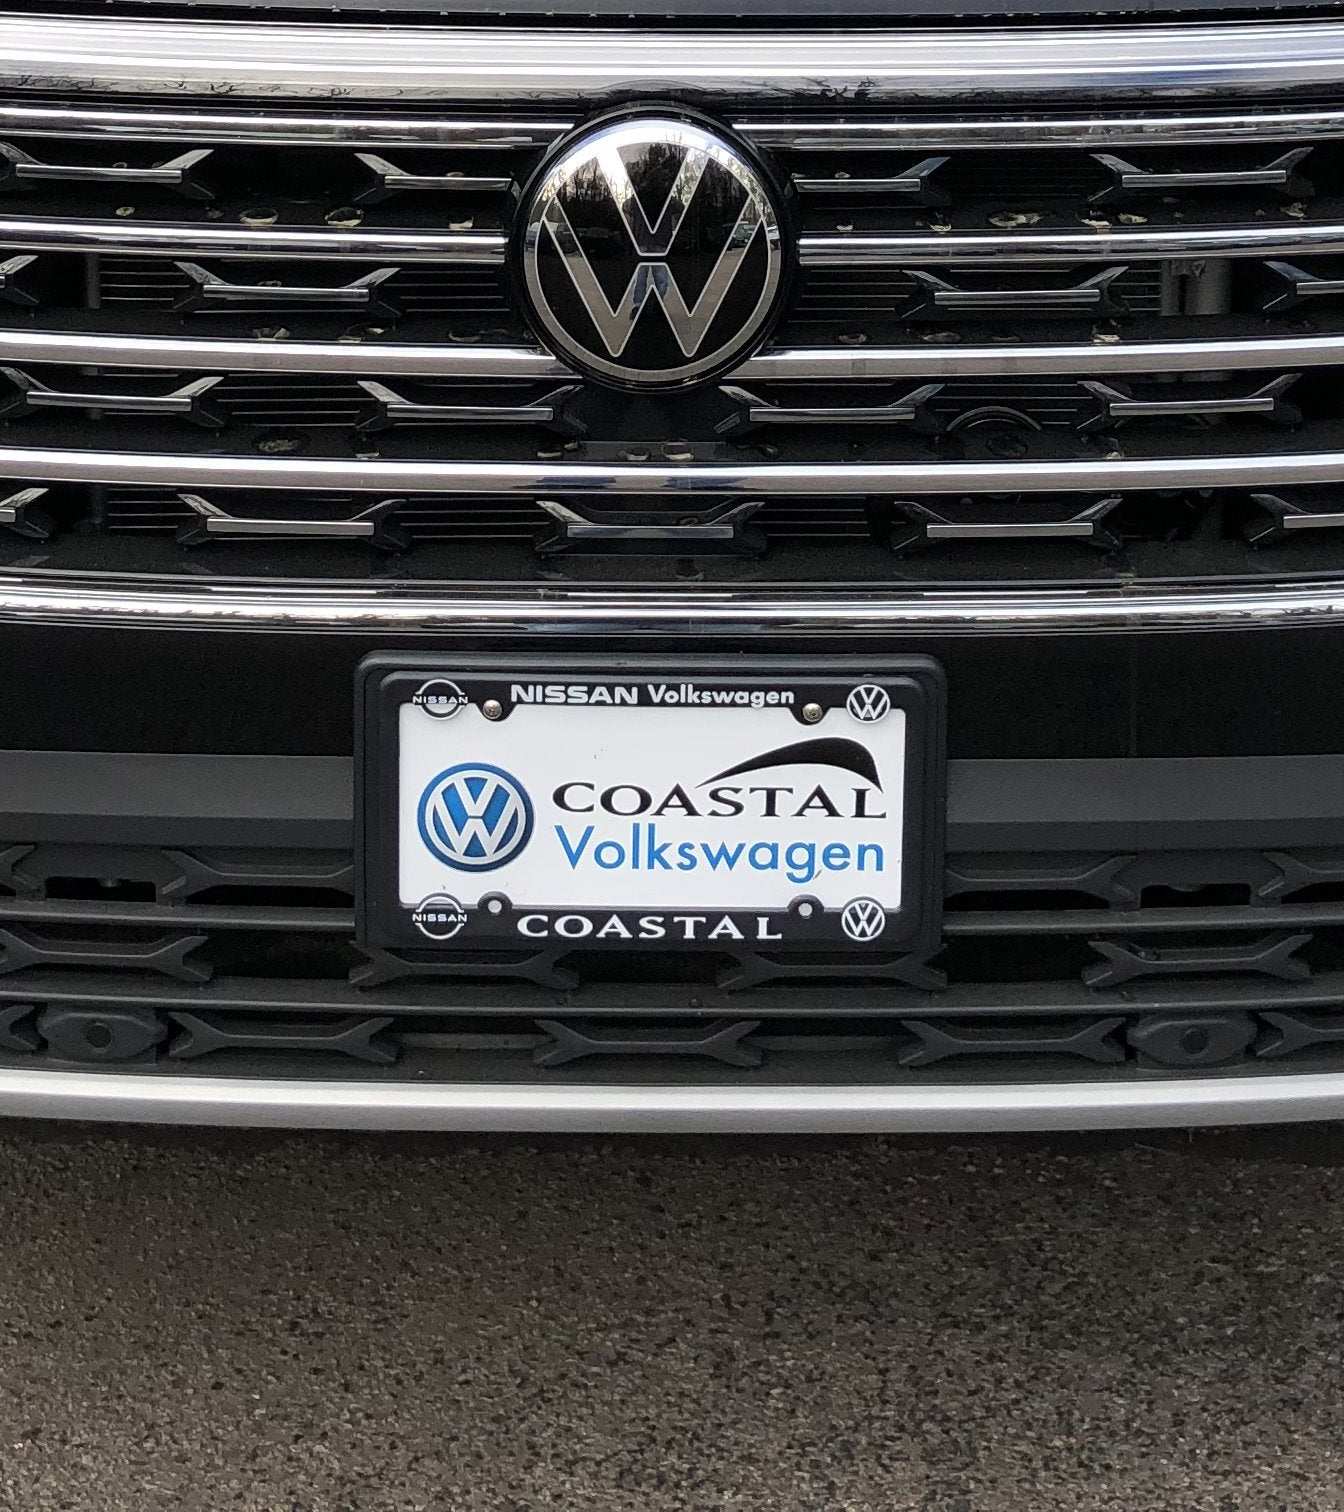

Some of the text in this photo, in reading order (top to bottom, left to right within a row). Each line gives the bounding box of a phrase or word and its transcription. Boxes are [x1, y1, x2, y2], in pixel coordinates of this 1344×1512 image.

[536, 136, 770, 360] VW
[412, 695, 469, 705] NISSAN
[510, 683, 795, 708] NISSAN Volkswagen
[848, 685, 889, 721] VW
[423, 769, 528, 866] VW
[553, 782, 887, 820] COASTAL
[554, 823, 885, 884] Volkswagen
[412, 913, 468, 923] NISSAN
[517, 914, 783, 941] COASTAL
[843, 897, 884, 938] VW
